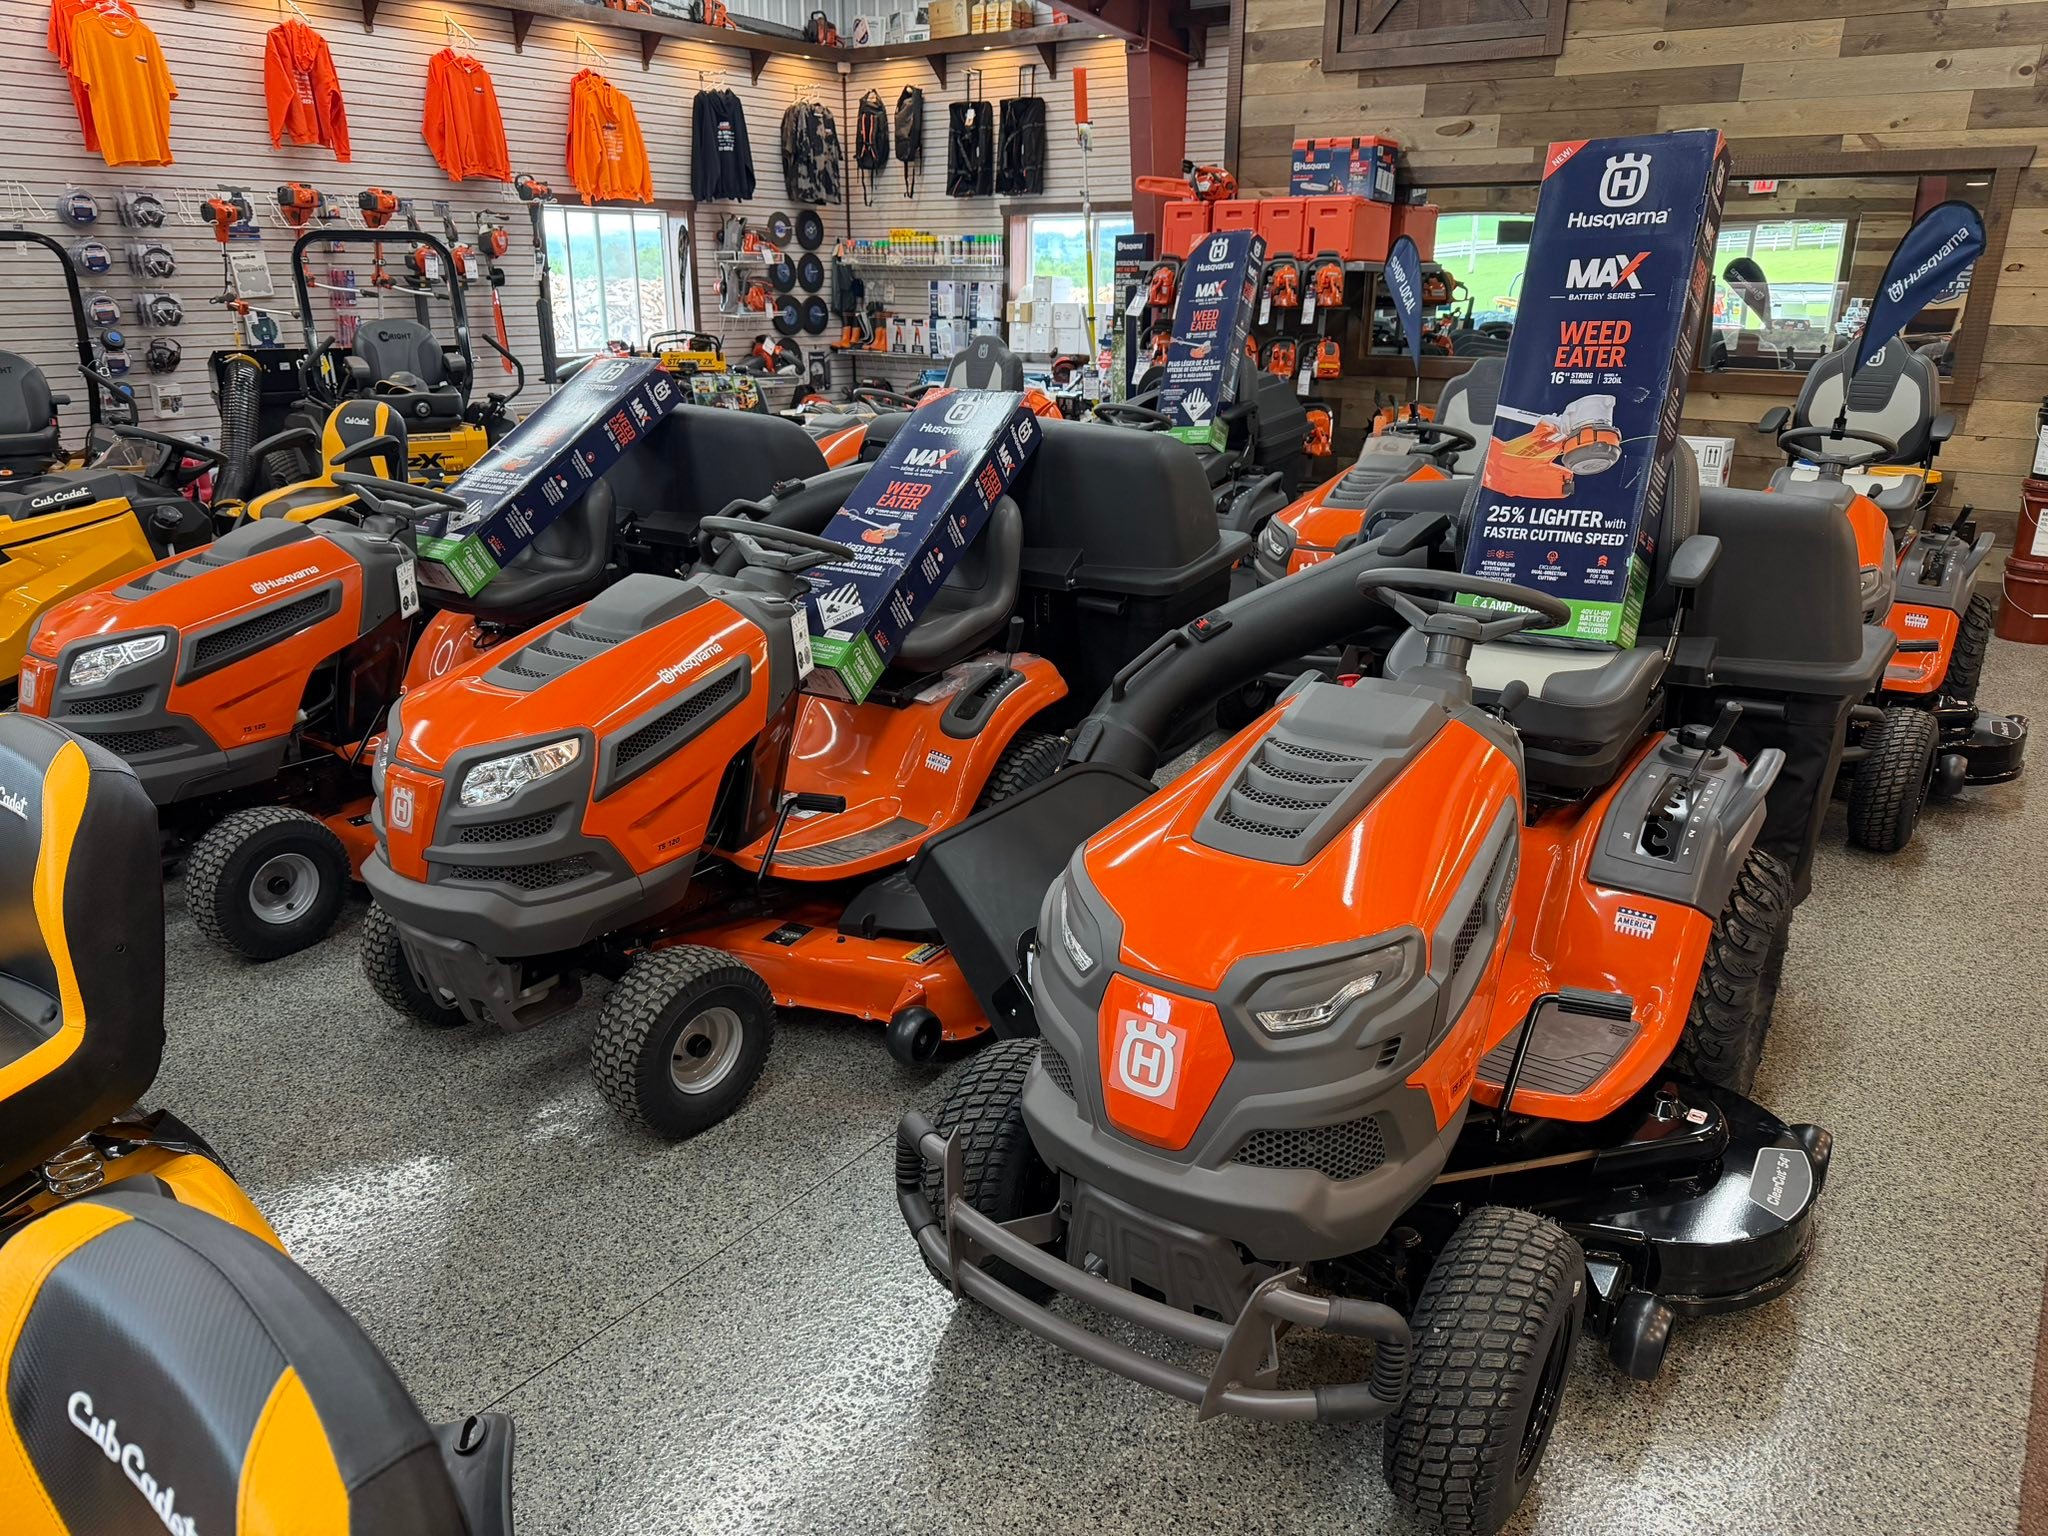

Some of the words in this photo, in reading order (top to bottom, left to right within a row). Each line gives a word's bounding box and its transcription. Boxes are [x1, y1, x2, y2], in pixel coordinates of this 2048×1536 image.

[1300, 162, 1330, 170] Husqvarna
[1552, 146, 1574, 167] NEW!
[1567, 210, 1669, 229] Husqvarna
[1196, 261, 1235, 272] Husqvarna
[1903, 226, 1970, 290] Husqvarna
[1565, 252, 1652, 290] MAX
[1195, 280, 1227, 298] MAX
[1391, 255, 1406, 283] SHOP
[1399, 280, 1416, 315] LOCAL
[1568, 293, 1604, 301] BATTERY
[1606, 292, 1636, 300] SERIES
[1191, 320, 1217, 331] EATER
[1193, 309, 1220, 322] WEED
[1560, 320, 1632, 345] WEED
[1554, 346, 1625, 368] EATER
[1550, 371, 1571, 385] 16"
[643, 382, 663, 415] Husqvarna
[344, 416, 355, 425] Cub
[354, 417, 370, 426] Cadet
[630, 397, 653, 427] MAX
[607, 417, 629, 448] EATER
[615, 409, 637, 441] WEED
[919, 423, 979, 436] Husqvarna
[1009, 423, 1026, 461] Husqvarna
[903, 448, 960, 470] MAX
[998, 442, 1016, 478] MAX
[979, 470, 996, 505] EATER
[985, 459, 1003, 496] WEED
[31, 496, 55, 508] Cub
[54, 486, 89, 502] Cadet
[885, 480, 932, 497] WEED
[875, 495, 922, 511] EATER
[1486, 505, 1525, 524] 25%
[1529, 507, 1603, 529] LIGHTER
[1604, 518, 1627, 530] with
[1483, 525, 1528, 541] FASTER
[1530, 528, 1583, 545] CUTTING
[864, 546, 878, 555] DE
[877, 547, 889, 556] 25
[264, 565, 320, 589] Husqvarna
[1531, 569, 1568, 577] DUAL-DIRECTION
[1480, 600, 1488, 608] 4
[1489, 601, 1513, 612] AMP
[1579, 614, 1610, 623] BATTERY
[1577, 626, 1608, 635] INCLUDED
[673, 643, 724, 678] Husqvarna
[658, 843, 666, 851] TS
[668, 836, 680, 846] 120
[1617, 917, 1653, 931] AMERICA
[1766, 1169, 1787, 1207] ClearCut
[67, 1391, 121, 1463] Cub
